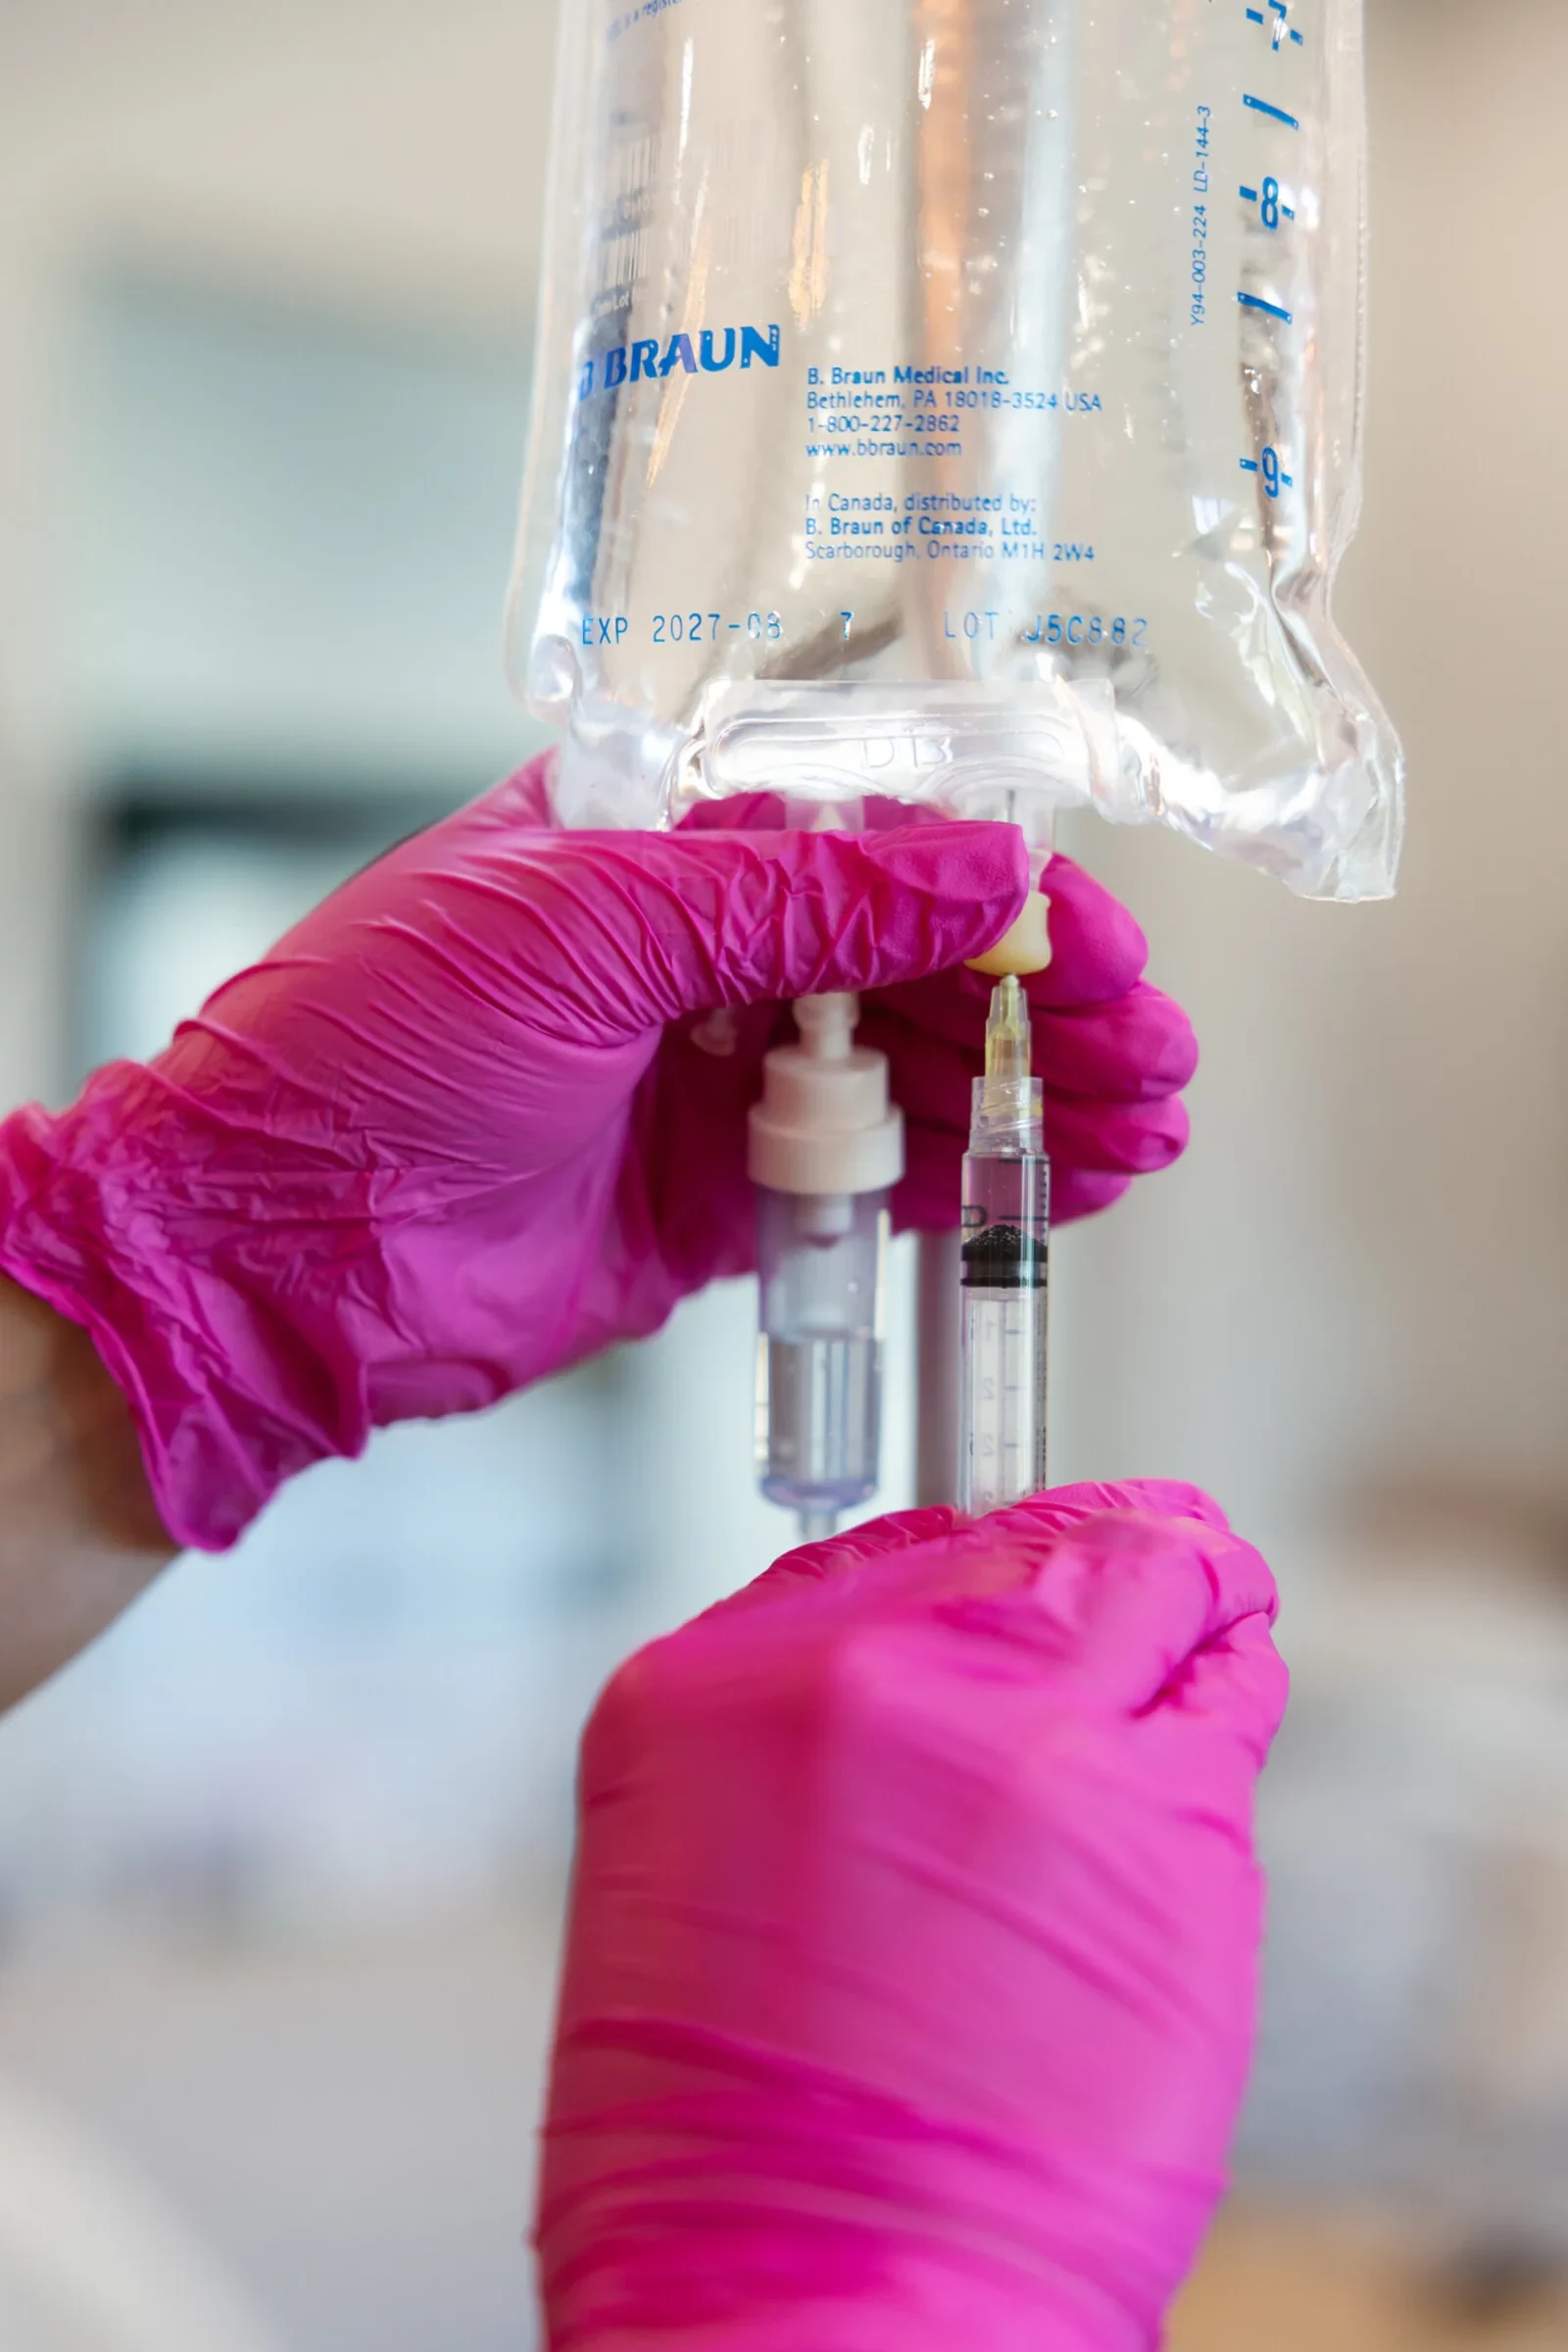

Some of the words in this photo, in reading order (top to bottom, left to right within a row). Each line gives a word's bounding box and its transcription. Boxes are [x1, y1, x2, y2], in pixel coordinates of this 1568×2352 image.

[1193, 105, 1211, 193] LD-144-3
[1190, 205, 1207, 326] Y94-003-224
[604, 323, 781, 390] BRAUN
[807, 367, 824, 385] B.
[831, 366, 886, 385] Braun
[893, 366, 969, 385] Medical
[975, 367, 1009, 385] Inc.
[806, 390, 906, 412] Bethlehem,
[912, 389, 938, 409] PA
[944, 390, 1059, 411] 18018-3524
[1064, 392, 1103, 413] USA
[807, 415, 960, 434] 1-800-227-2862
[805, 439, 962, 458] www.bbraun.com
[805, 493, 820, 512] In
[827, 493, 899, 514] Canada,
[904, 492, 1003, 512] distributed
[1008, 493, 1038, 515] by:
[805, 517, 822, 535] B.
[830, 516, 885, 536] Braun
[891, 516, 912, 536] of
[917, 516, 994, 538] Canada,
[1001, 516, 1038, 536] Ltd.
[805, 540, 920, 563] Scarborough,
[926, 540, 995, 560] Ontario
[1001, 542, 1046, 560] M1H
[1053, 543, 1096, 562] 2W4
[581, 616, 629, 646] EXP
[652, 611, 783, 644] 2027-08
[943, 611, 1000, 640] LOT
[1024, 613, 1149, 647] J5C882
